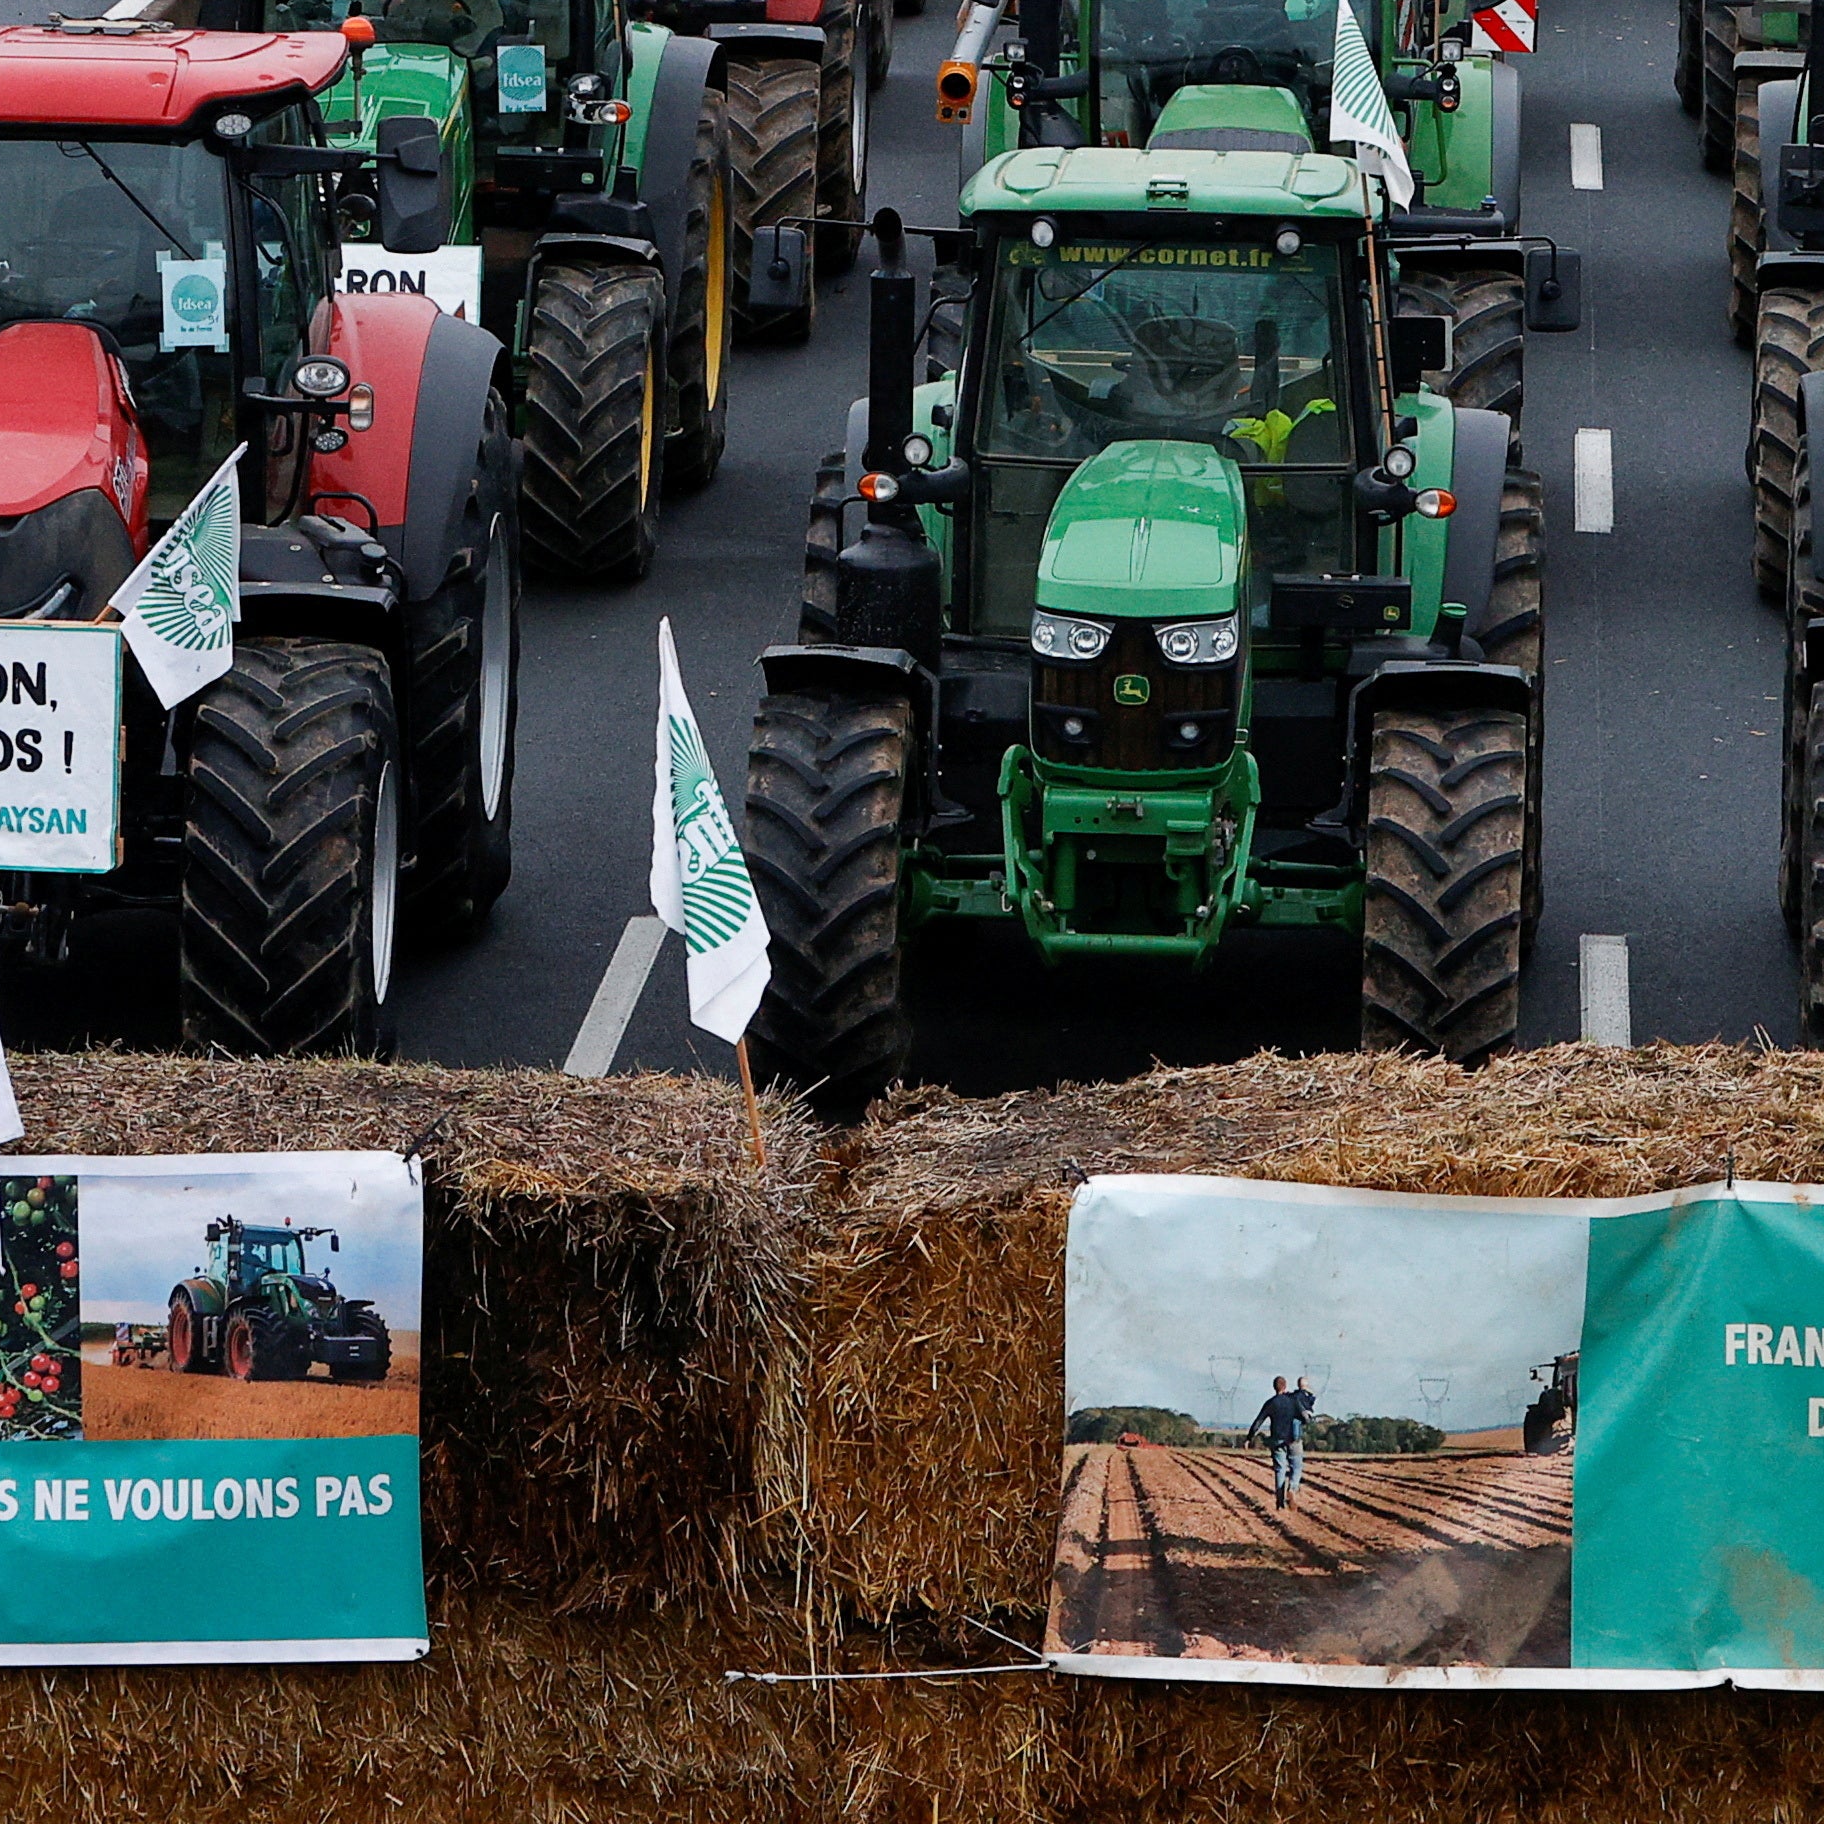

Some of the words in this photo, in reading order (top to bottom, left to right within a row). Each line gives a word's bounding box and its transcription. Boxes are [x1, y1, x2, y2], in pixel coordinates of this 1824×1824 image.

[1058, 244, 1273, 268] www.cornet.fr
[341, 268, 426, 294] RON
[62, 729, 75, 775] !
[34, 1478, 90, 1522] NE
[106, 1476, 300, 1521] VOULONS
[316, 1472, 394, 1517] PAS
